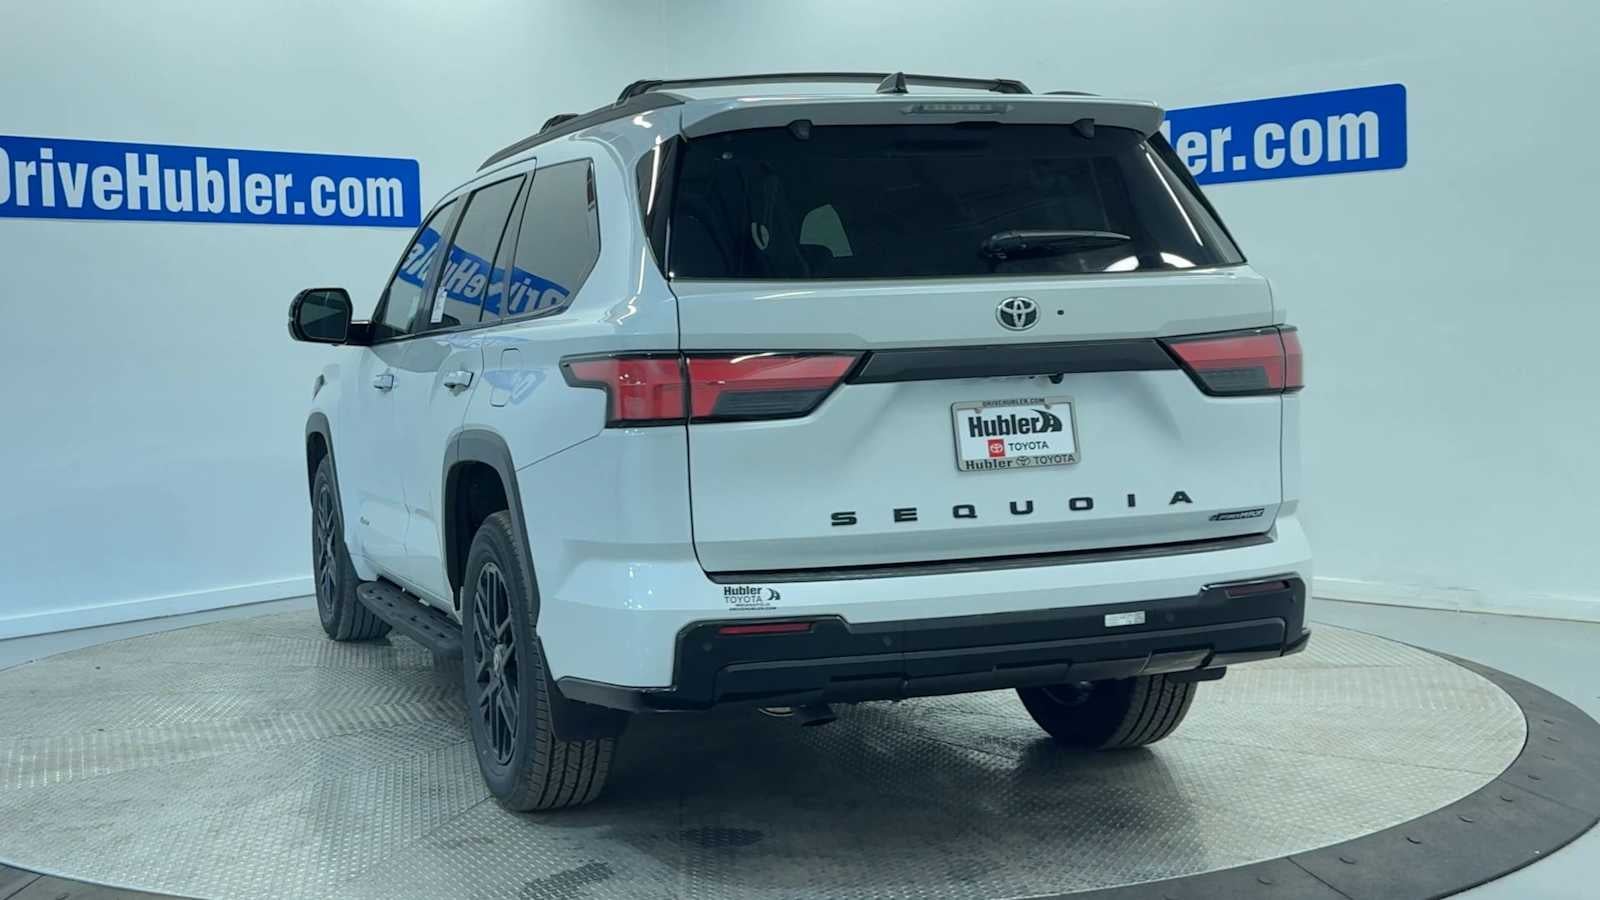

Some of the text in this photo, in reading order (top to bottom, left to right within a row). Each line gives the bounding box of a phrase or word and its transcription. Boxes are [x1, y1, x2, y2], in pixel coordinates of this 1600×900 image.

[968, 414, 1040, 437] Hubler
[1008, 441, 1049, 451] TOYOTA
[965, 454, 1076, 470] Hubler TOYOTA
[831, 491, 1193, 526] SEQUOIA
[724, 586, 762, 595] Hubler
